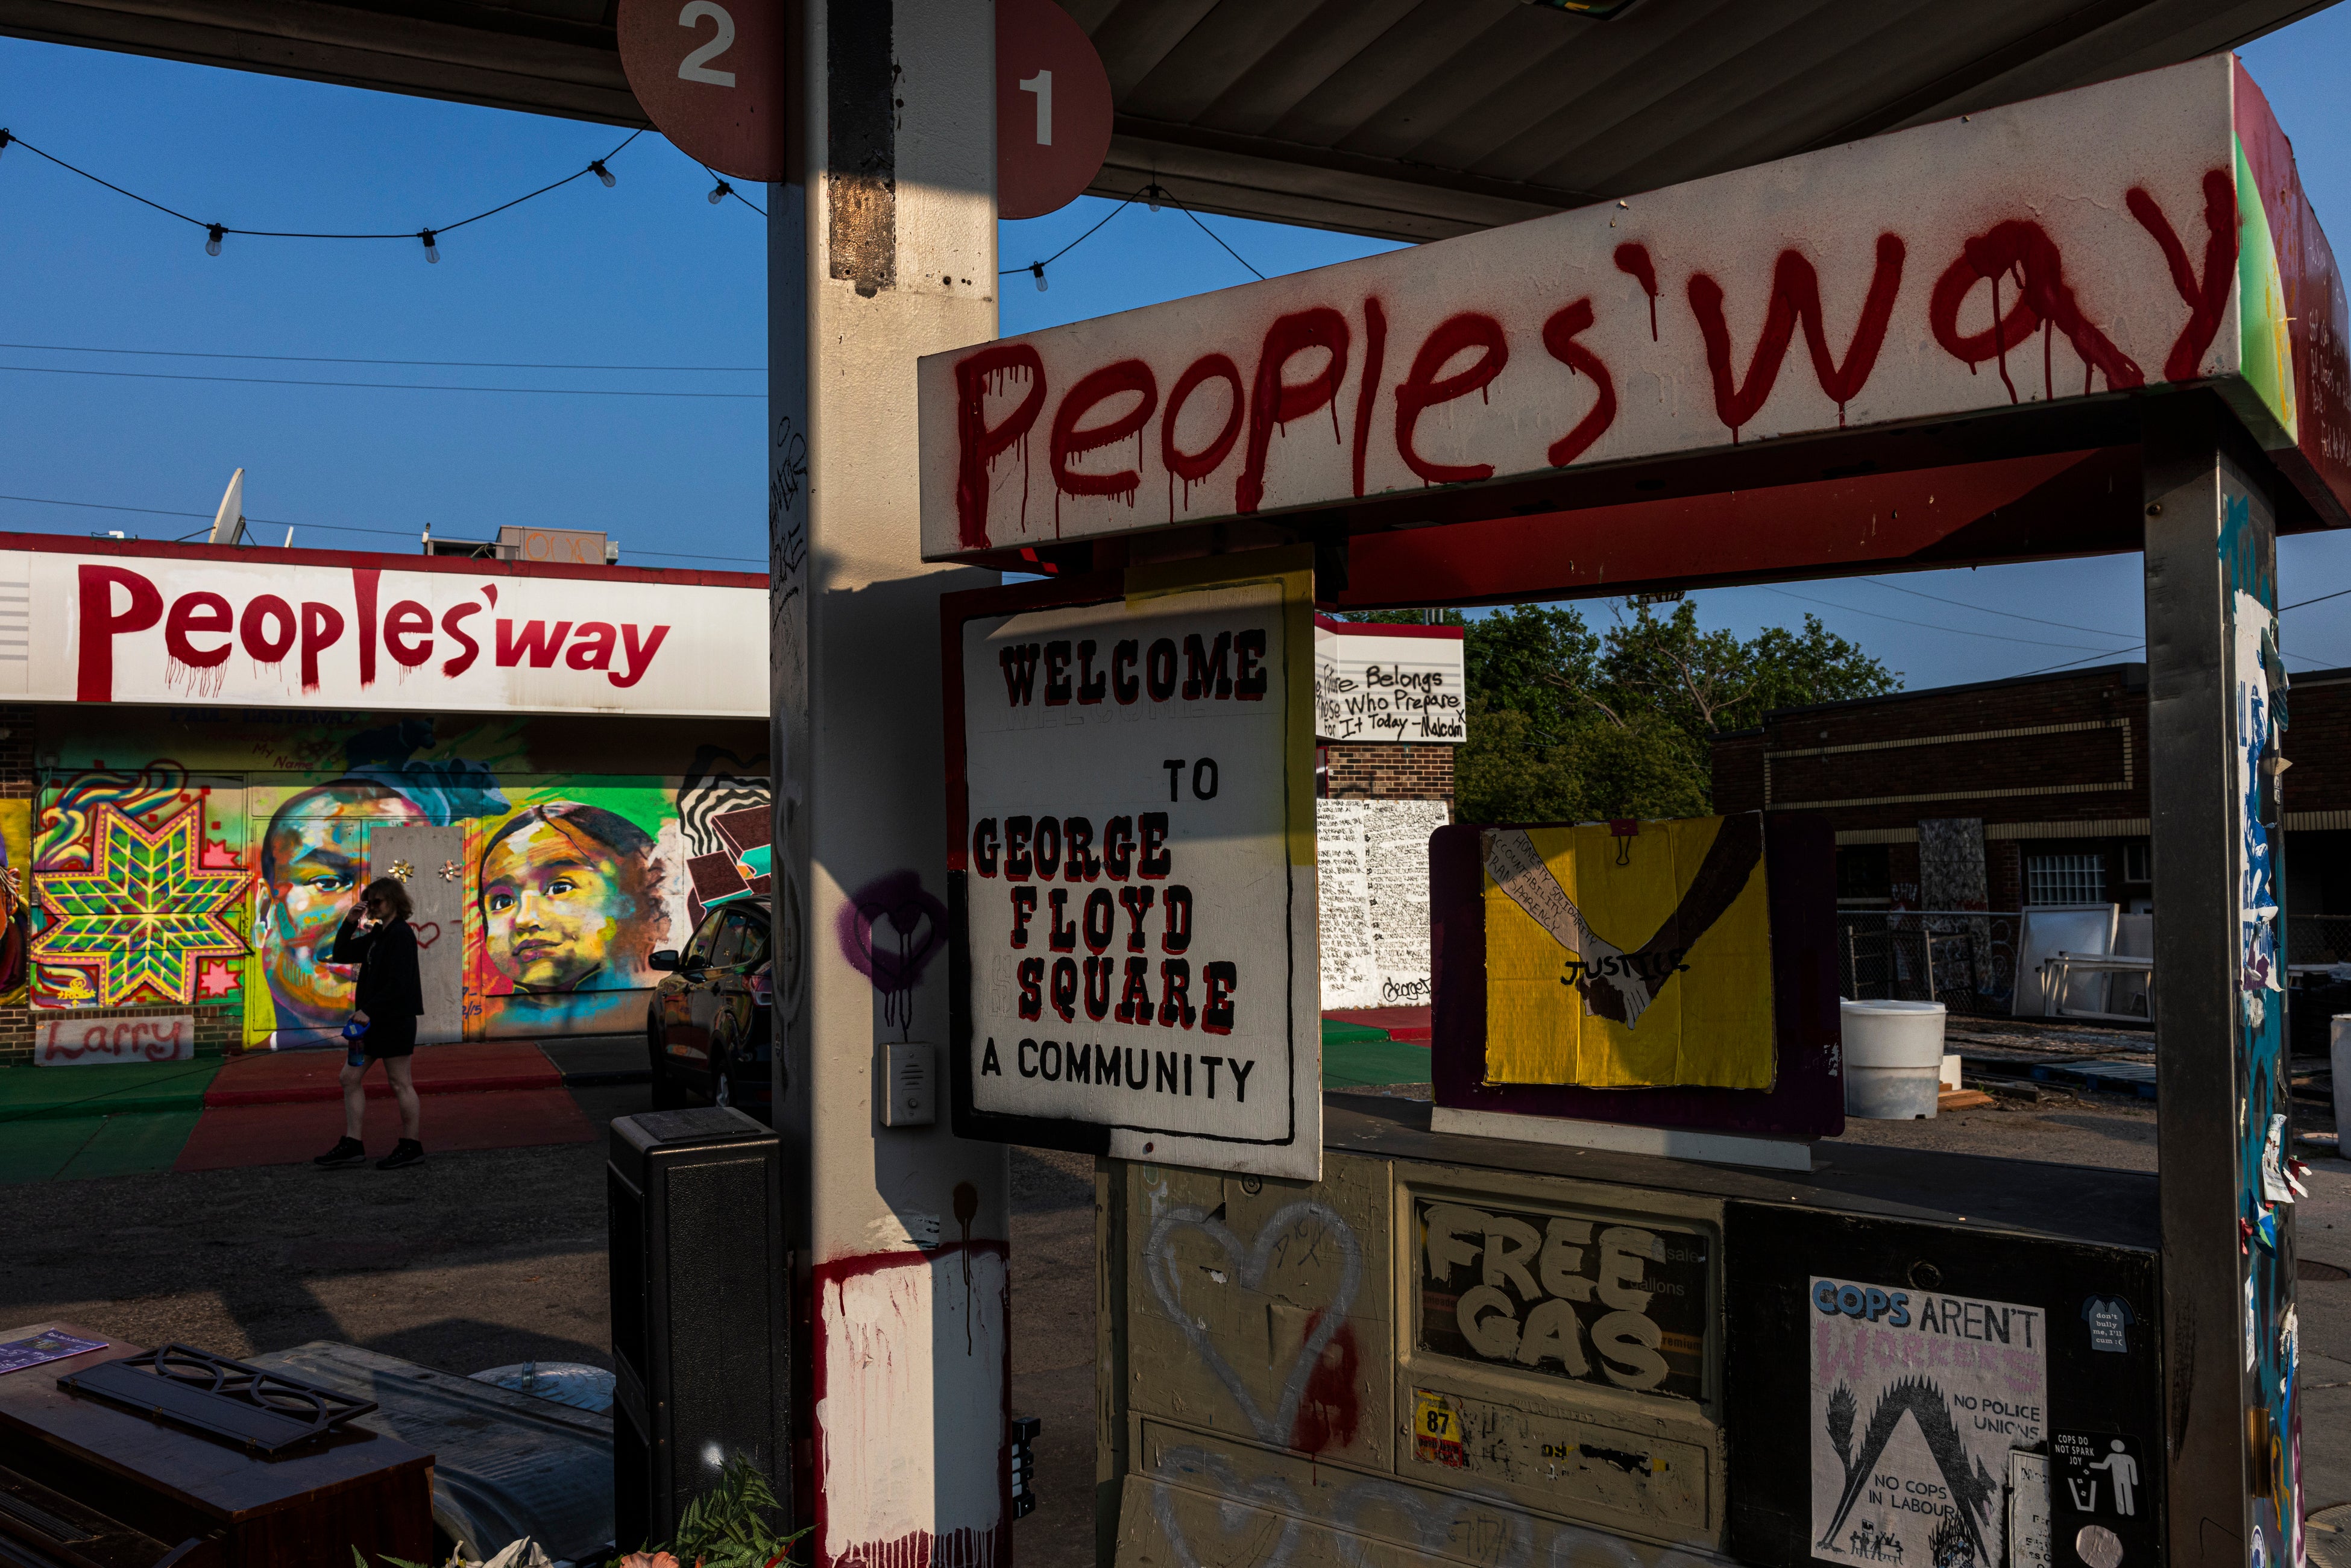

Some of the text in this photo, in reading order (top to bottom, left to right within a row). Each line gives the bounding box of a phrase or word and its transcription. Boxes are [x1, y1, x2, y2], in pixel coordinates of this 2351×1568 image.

[677, 0, 735, 87] 2
[1020, 69, 1052, 146] 1
[999, 629, 1267, 706] WELCOME
[1367, 665, 1442, 693] Belongs
[1317, 690, 1459, 719] Those Who Prepare
[1339, 717, 1362, 738] It
[1368, 713, 1408, 741] Today
[1456, 709, 1465, 723] X
[253, 743, 274, 758] My
[273, 756, 314, 770] Name
[1163, 758, 1218, 802] TO
[974, 812, 1171, 883] GEORGE
[1513, 836, 1551, 883] HONESTY
[1489, 851, 1560, 933] TRANSPARENCY
[1491, 834, 1563, 917] ACCOUNTABILITY
[1011, 886, 1193, 955] FLOYD
[1560, 948, 1690, 985] JUSTICE
[1018, 956, 1237, 1035] SQUARE
[45, 1021, 181, 1062] Larry
[981, 1037, 1255, 1103] A COMMUNITY
[1424, 1204, 1666, 1314] FREE
[1667, 1248, 1699, 1264] sale
[1812, 1280, 2038, 1348] COPS AREN'T
[2095, 1321, 2117, 1329] bully
[1456, 1285, 1670, 1390] GAS
[1662, 1337, 1702, 1351] remium
[1816, 1319, 2041, 1395] WORKERS
[1427, 1411, 1449, 1434] 87
[1954, 1393, 2040, 1422] NO POLICE
[2054, 1444, 2095, 1456] NOT SPARK
[2058, 1434, 2088, 1446] COPS DO
[2069, 1456, 2083, 1466] JOY
[1869, 1490, 1954, 1519] IN LABOUR
[1875, 1475, 1947, 1499] NO COPS
